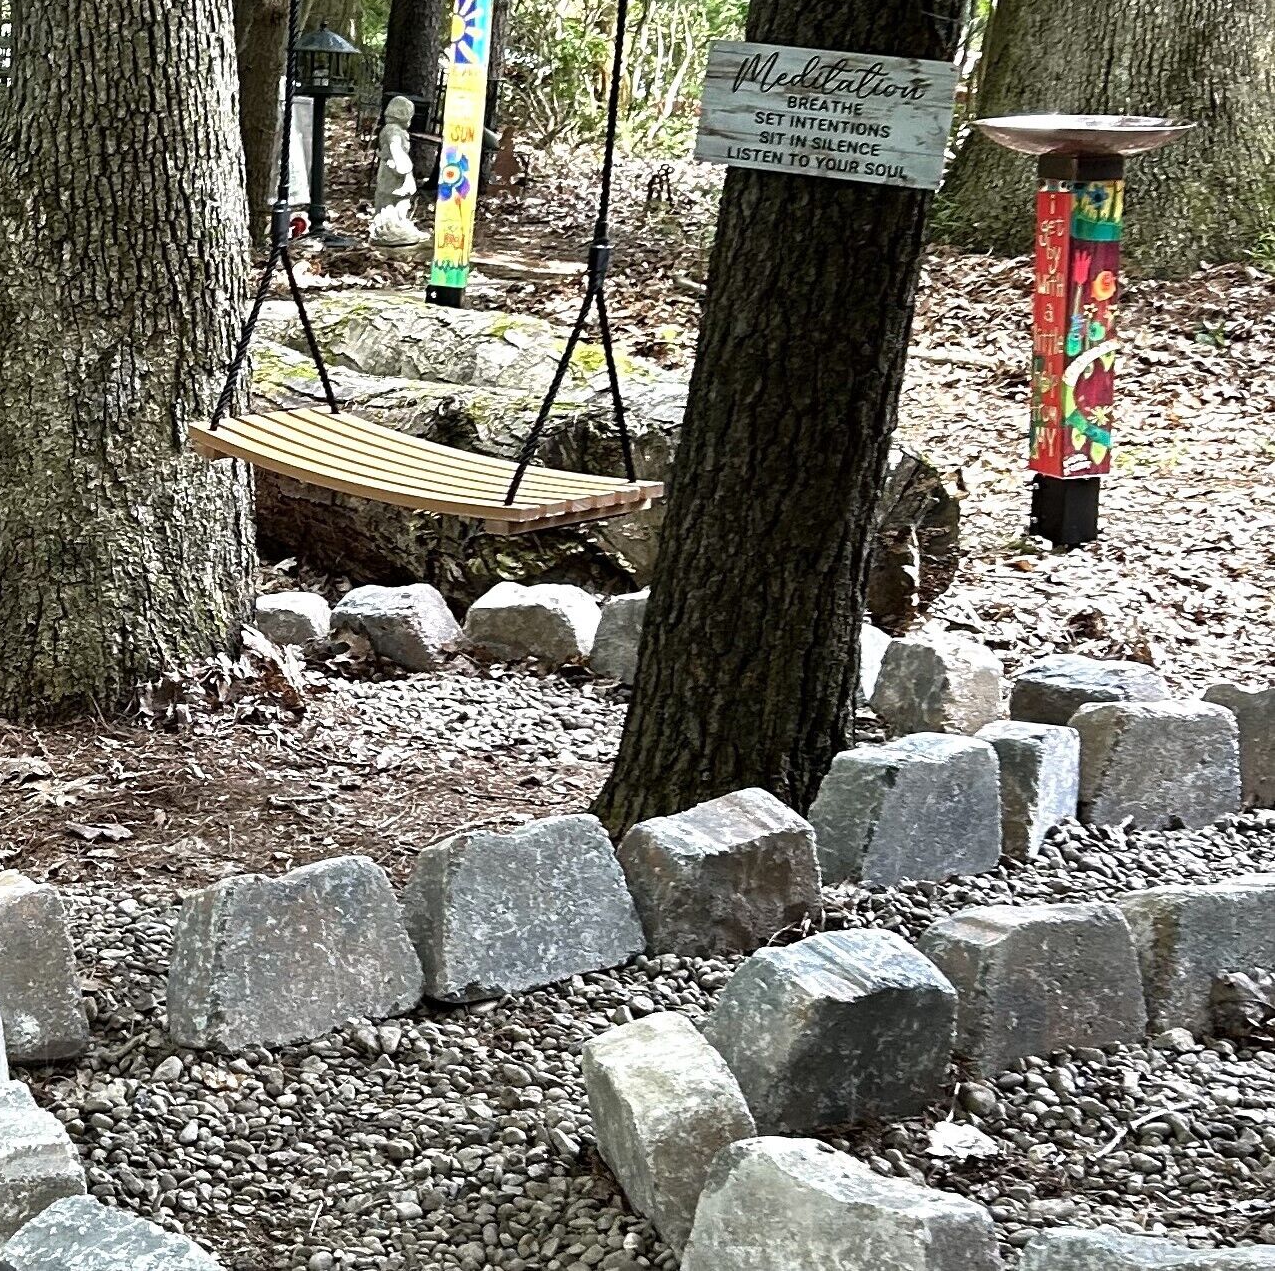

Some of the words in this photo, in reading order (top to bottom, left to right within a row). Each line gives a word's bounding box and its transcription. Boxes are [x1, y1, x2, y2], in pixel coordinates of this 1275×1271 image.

[732, 52, 926, 100] Meditation
[787, 95, 865, 117] BREATHE
[754, 111, 785, 127] SET
[790, 116, 891, 139] INTENTIONS
[759, 130, 785, 145] SIT
[789, 135, 807, 149] IN
[811, 137, 882, 158] SILENCE
[727, 146, 784, 165] LISTEN
[789, 154, 810, 169] TO
[815, 157, 859, 175] YOUR
[865, 163, 909, 181] SOUL
